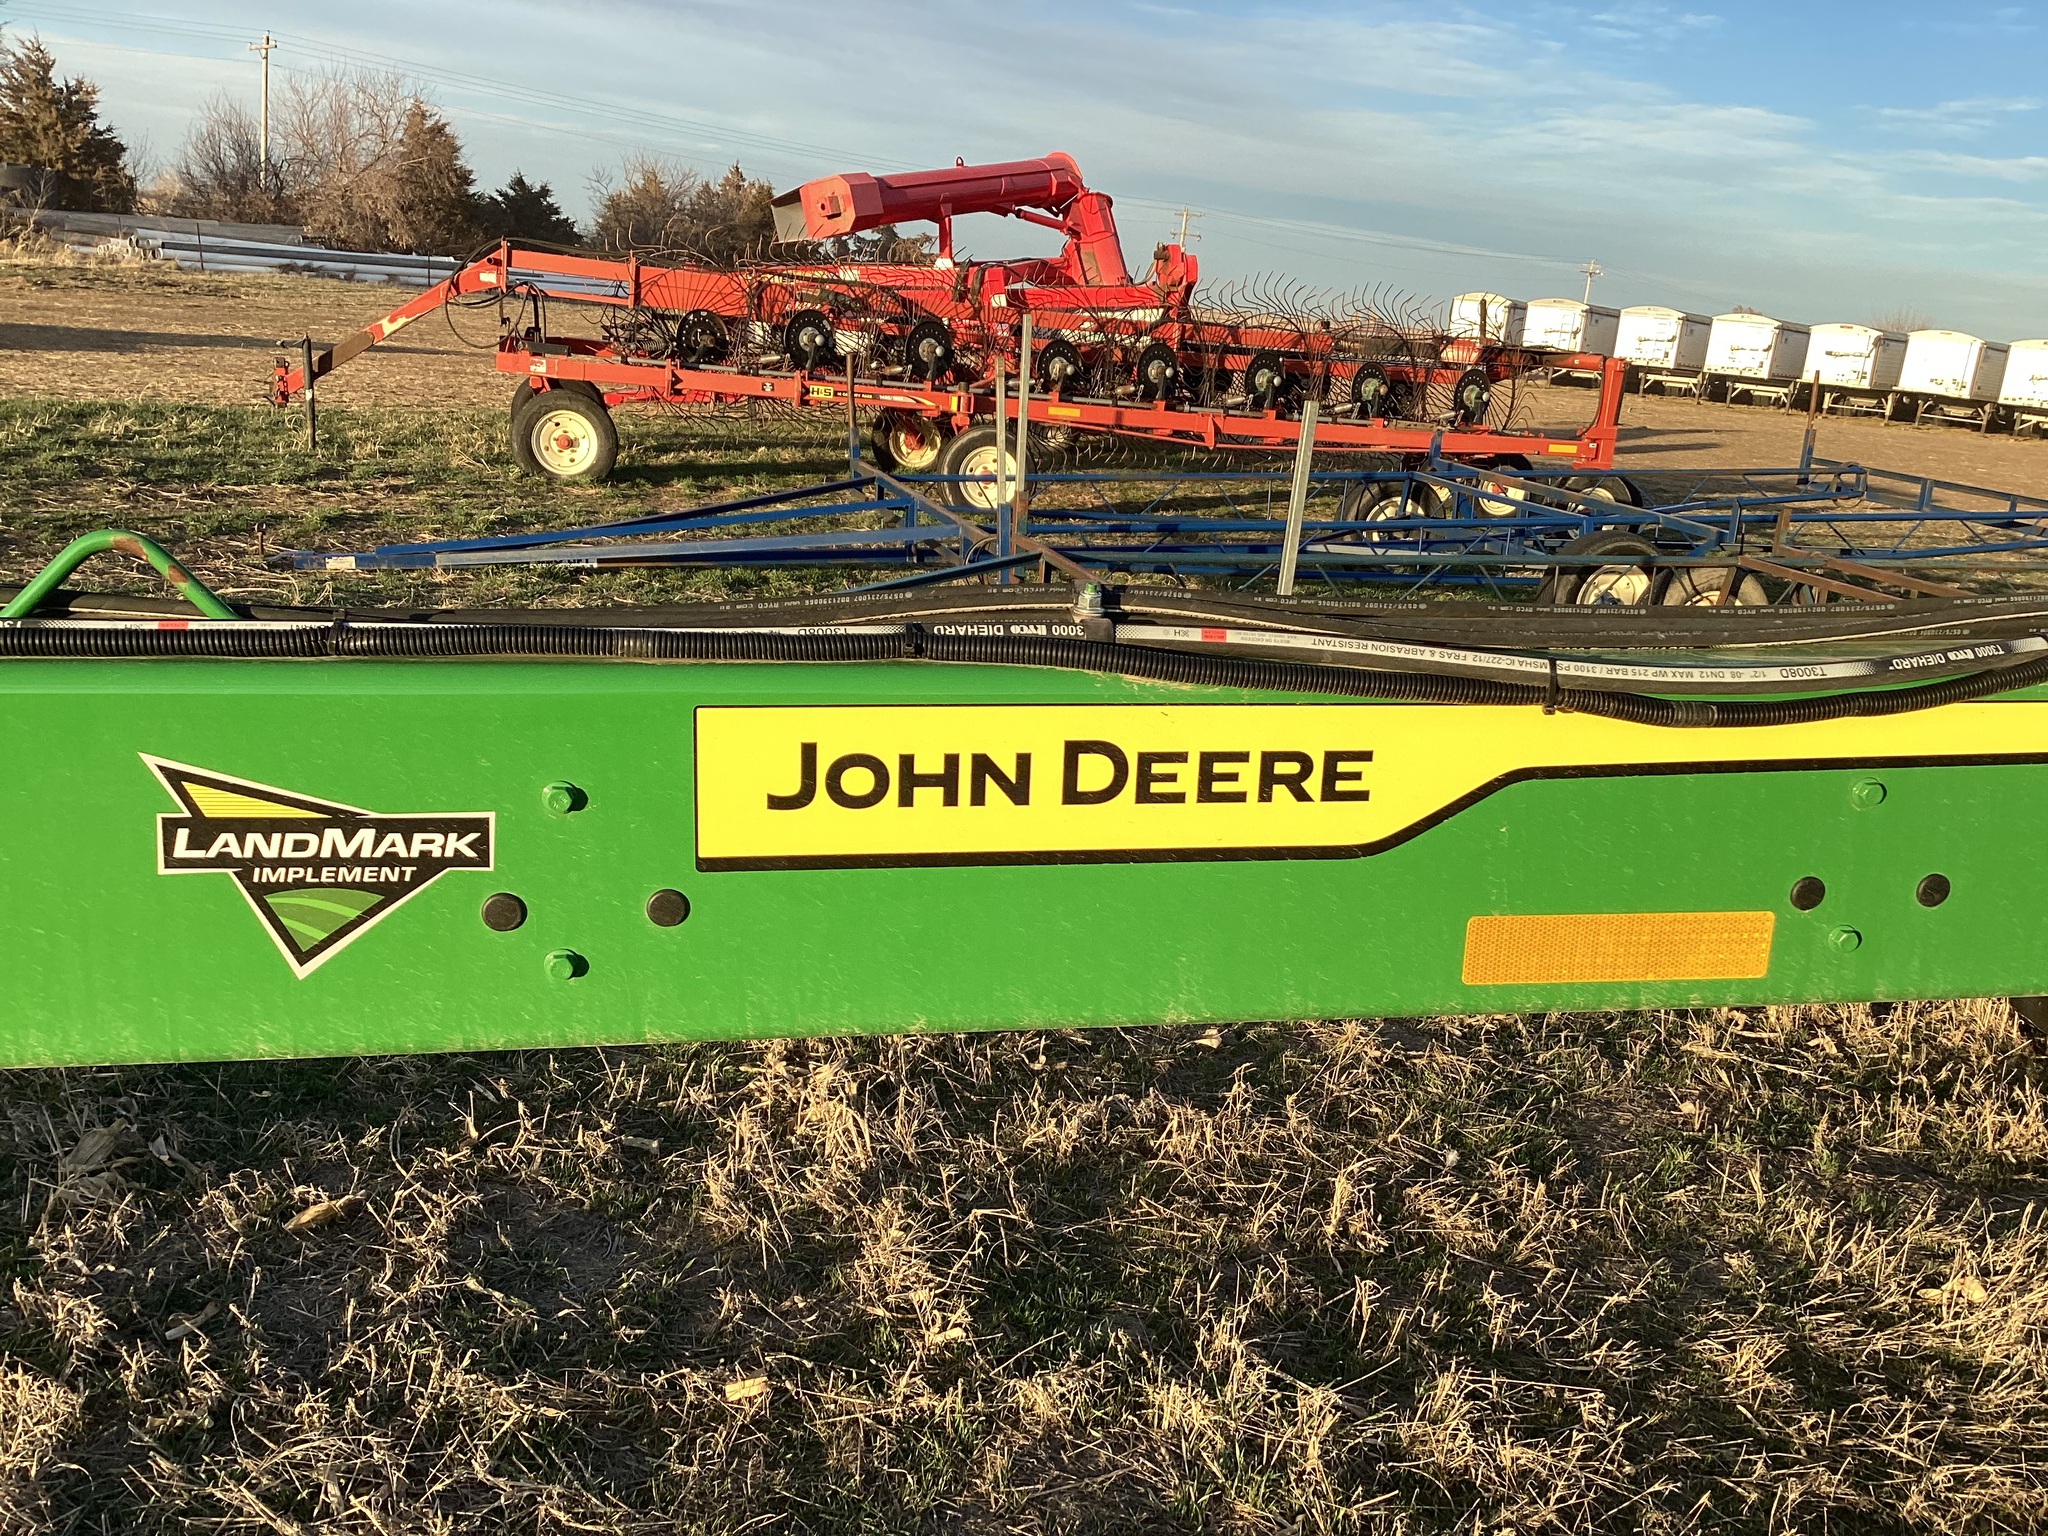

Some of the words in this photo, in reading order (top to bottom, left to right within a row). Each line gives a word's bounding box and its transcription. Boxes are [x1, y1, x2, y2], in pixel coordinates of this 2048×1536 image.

[811, 387, 832, 397] H&S
[933, 624, 1004, 636] DIEHARD
[1311, 638, 1368, 650] RESISTANT
[1371, 643, 1426, 657] ABRASION
[1429, 650, 1436, 659] &
[1439, 650, 1467, 661] FRAS
[1975, 644, 2005, 657] T3000
[1473, 654, 1516, 666] IC-227/12
[1517, 659, 1548, 670] MSHA
[1556, 662, 1571, 672] PS
[1574, 664, 1598, 675] 3100
[1606, 667, 1628, 676] BAR
[1631, 668, 1649, 677] 215
[1780, 666, 1828, 679] T3008D
[1651, 669, 1669, 678] WP
[1670, 670, 1694, 678] MAX
[1699, 670, 1725, 679] DN12
[766, 741, 1032, 811] JOHN
[1061, 739, 1375, 807] DEERE
[252, 866, 417, 883] IMPLEMENT
